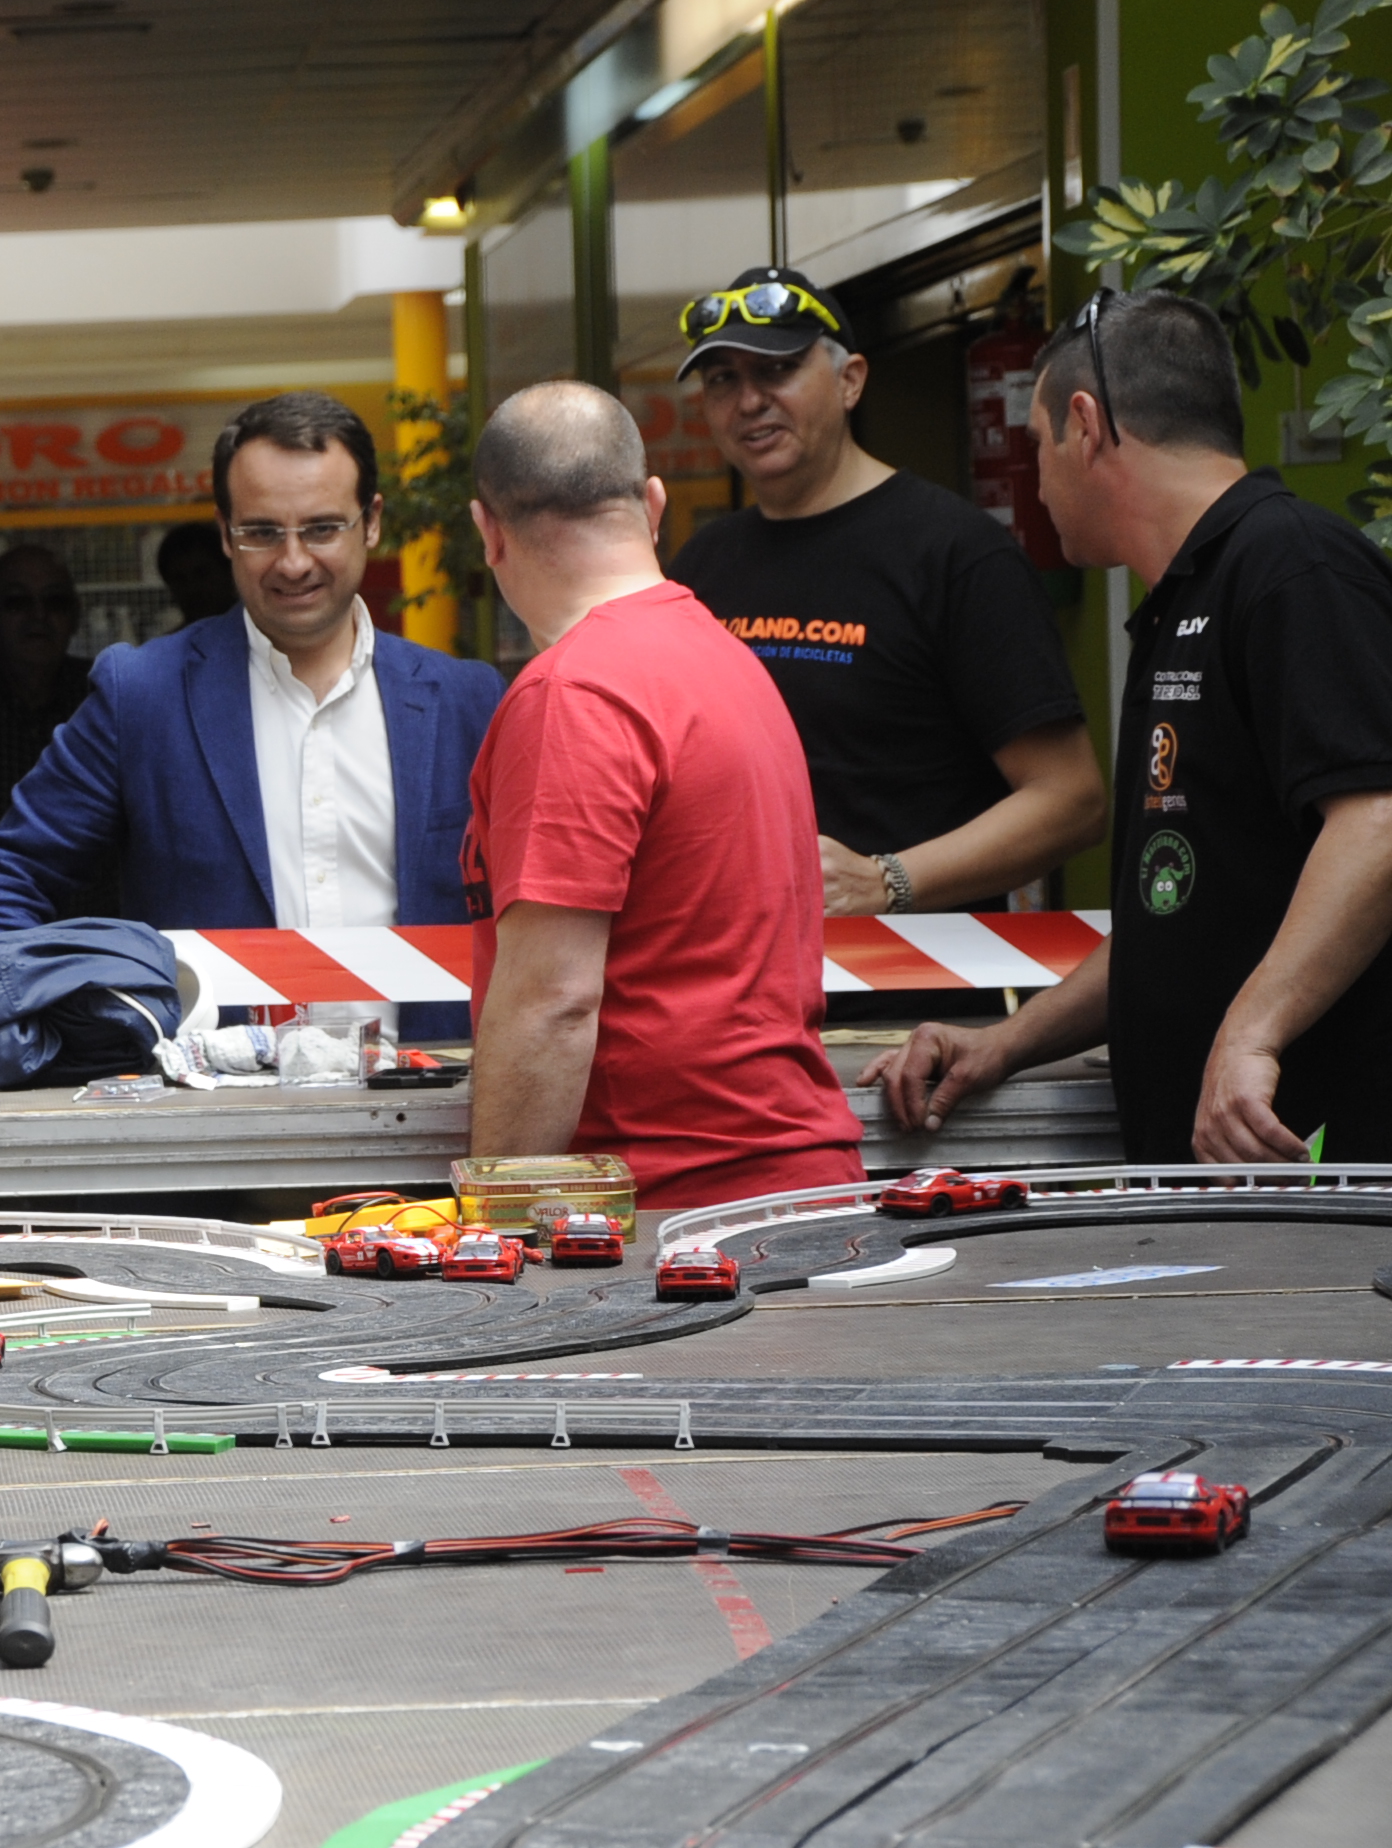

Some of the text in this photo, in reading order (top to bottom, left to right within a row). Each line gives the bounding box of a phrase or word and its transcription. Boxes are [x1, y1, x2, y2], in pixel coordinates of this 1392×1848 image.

[778, 645, 792, 659] DE
[793, 645, 854, 665] BICICLETAS
[532, 1206, 571, 1218] VALOR
